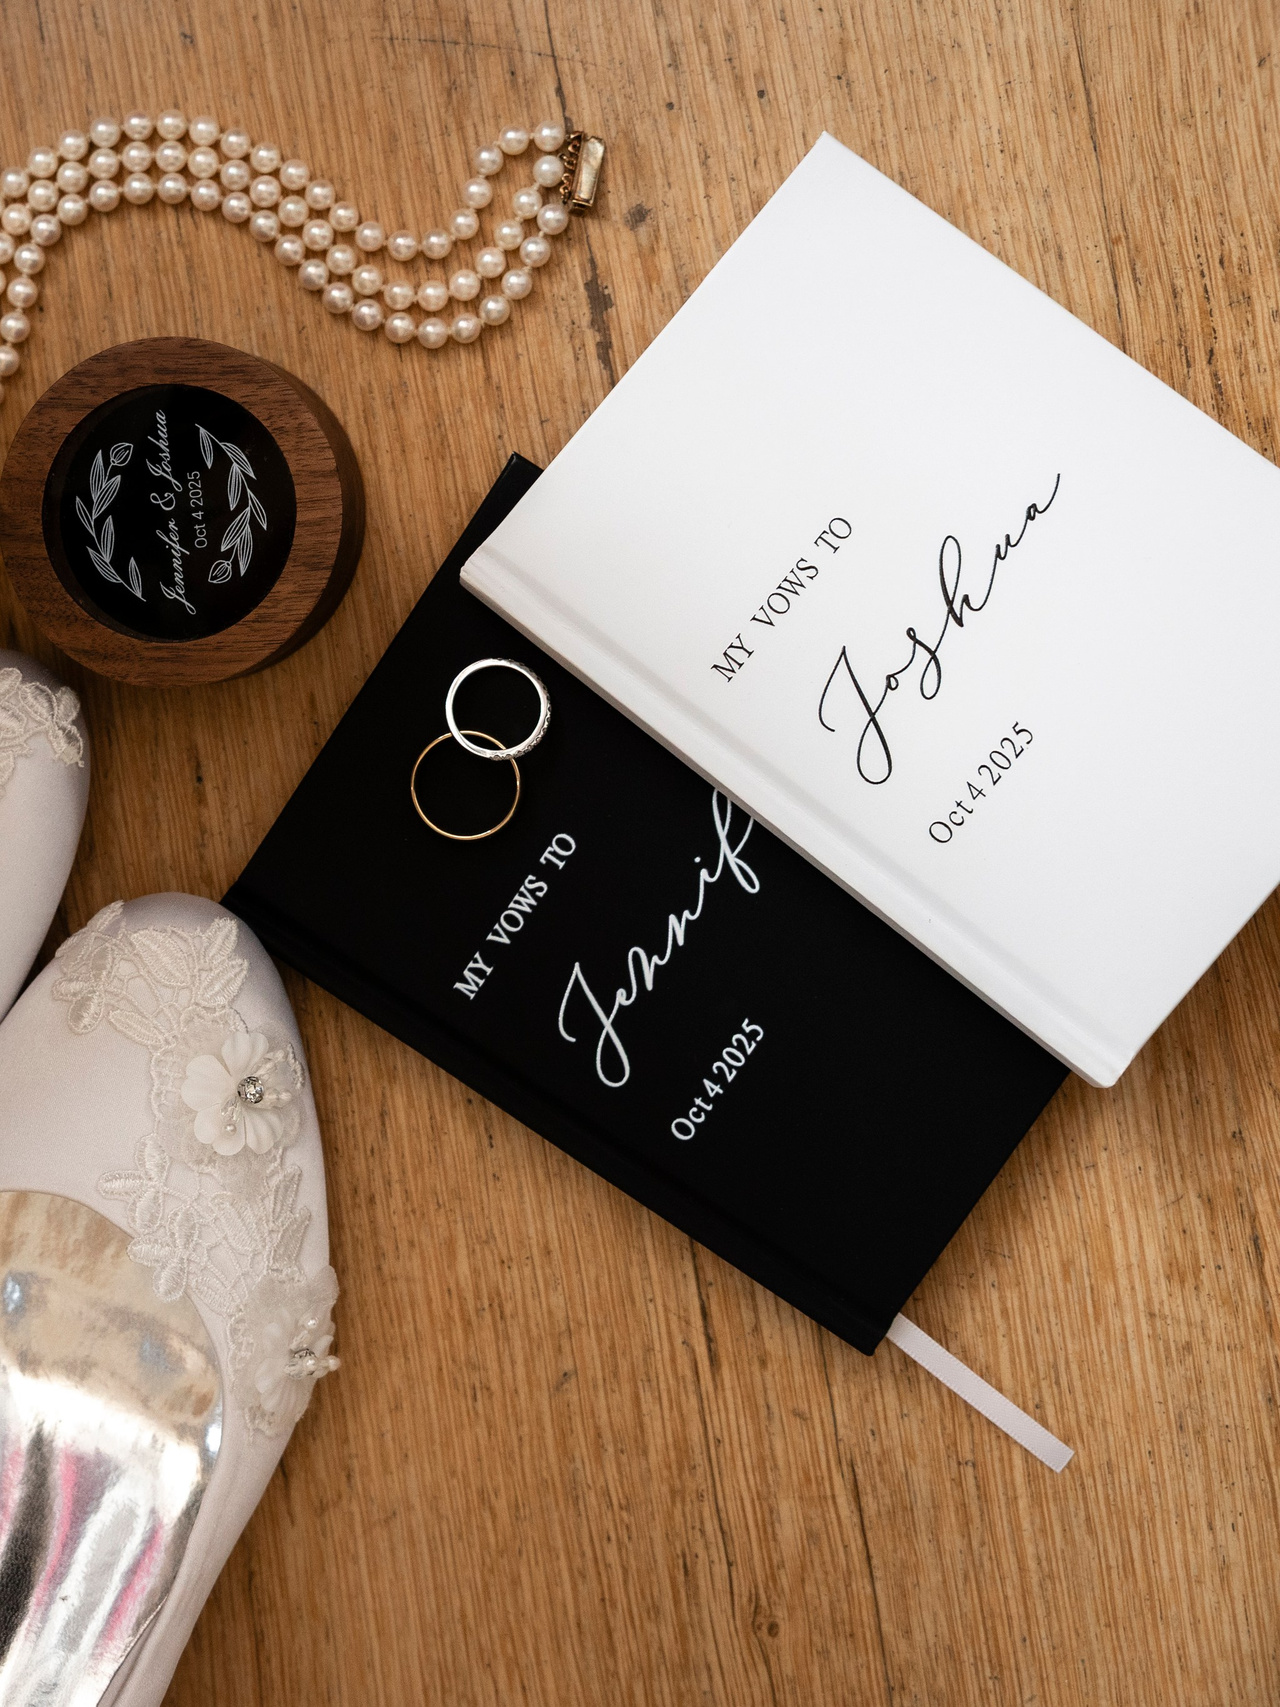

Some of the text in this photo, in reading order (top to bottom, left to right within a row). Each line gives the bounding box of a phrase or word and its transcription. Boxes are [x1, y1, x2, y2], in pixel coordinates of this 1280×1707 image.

[145, 409, 197, 615] Jennifer & Joshua
[187, 470, 208, 549] Oct 4 2025
[710, 516, 853, 683] MY VOWS TO
[818, 473, 1061, 785] Joshua
[928, 721, 1034, 844] Oct 4 2025
[453, 832, 577, 1000] MY VOWS TO
[558, 787, 760, 1087] Jennif
[670, 1018, 765, 1141] Oct 4 2025
